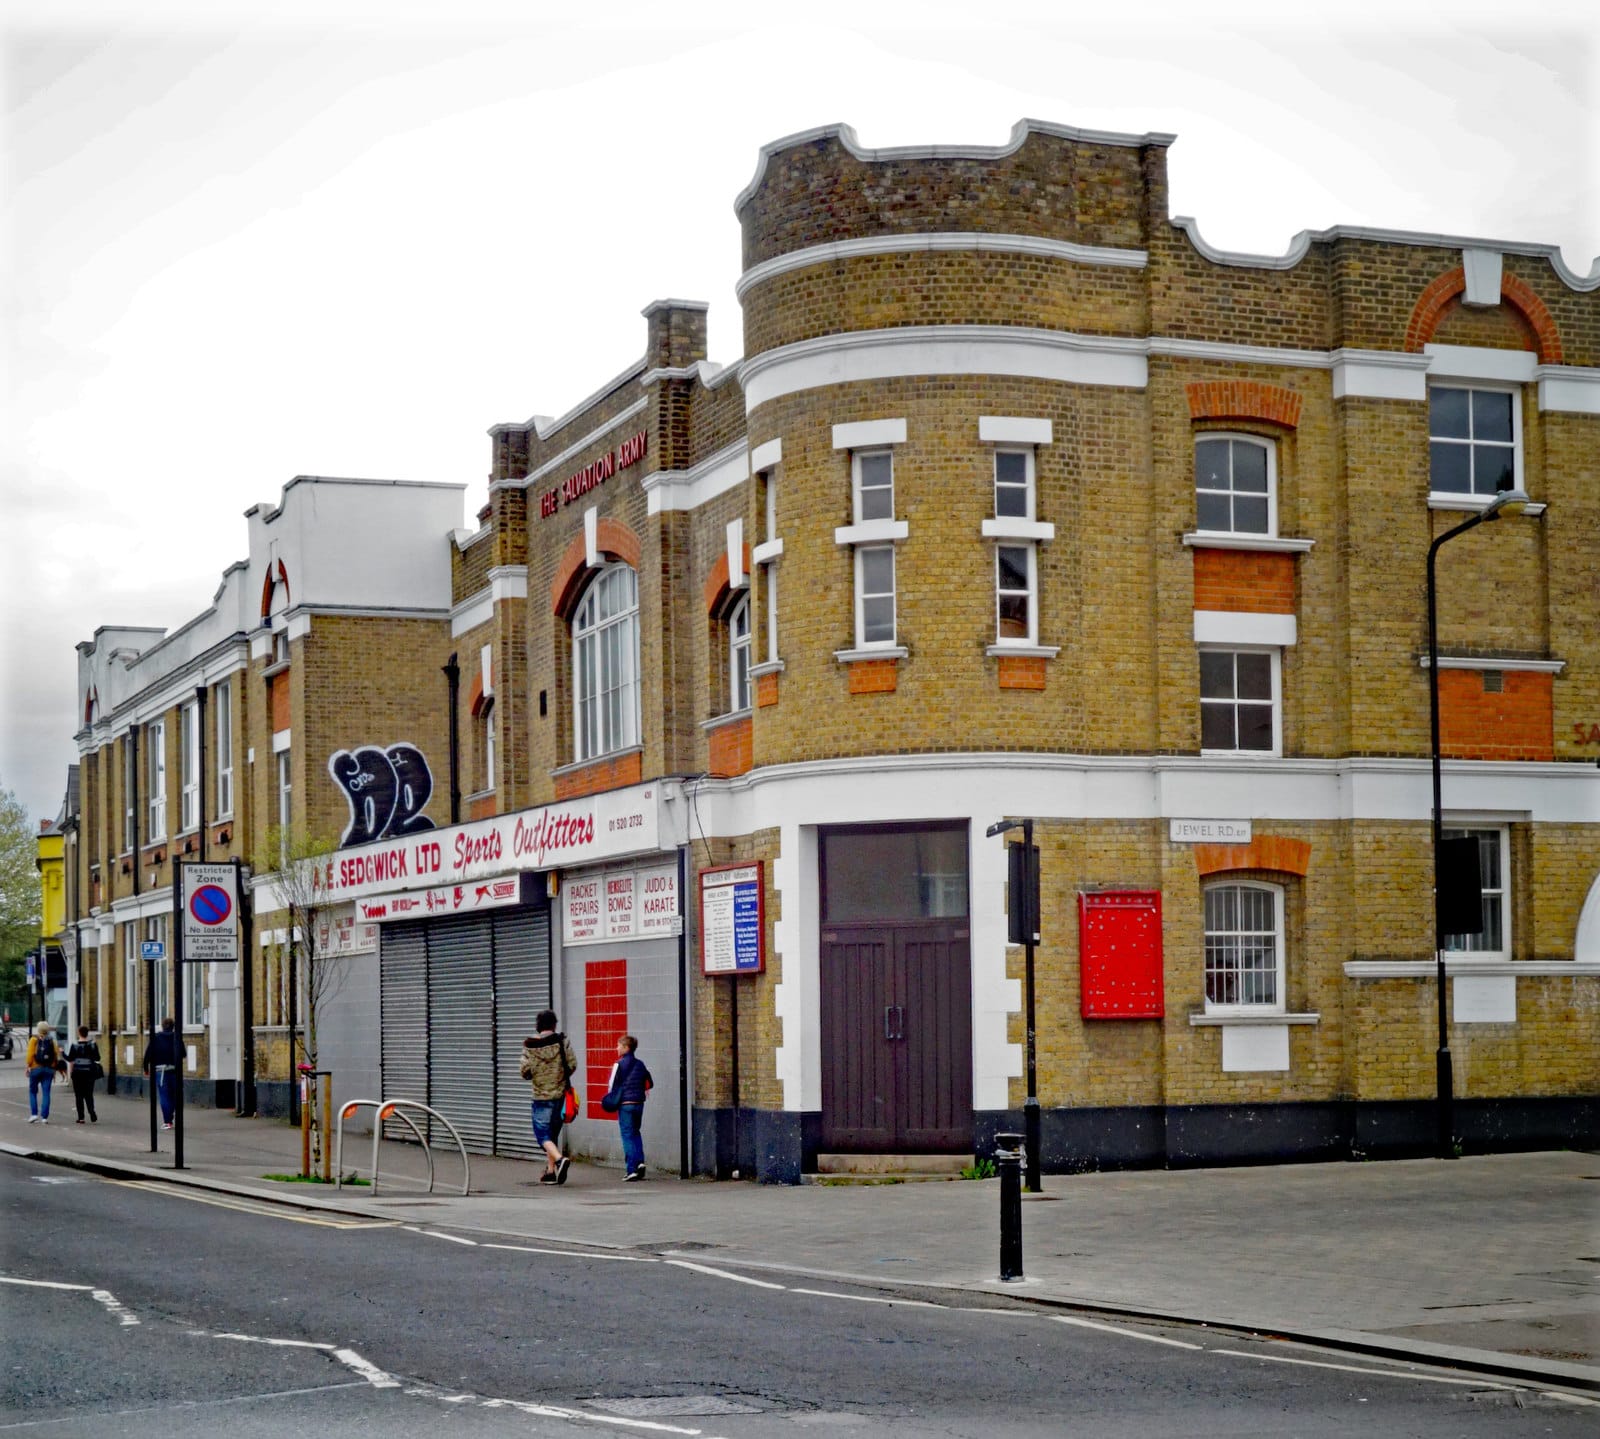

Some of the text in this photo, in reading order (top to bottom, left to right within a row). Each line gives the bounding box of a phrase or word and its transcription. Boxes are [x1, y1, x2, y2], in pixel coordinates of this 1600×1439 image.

[540, 428, 648, 519] THE SALVATION ARMY
[1175, 824, 1214, 836] JEWEL
[340, 848, 408, 888] SEDGWICK
[415, 842, 441, 875] LTD
[453, 828, 503, 875] Sports
[513, 808, 595, 867] Outfitters
[617, 817, 627, 830] 520
[629, 814, 643, 828] 2732
[196, 875, 224, 883] Zone
[644, 877, 673, 893] JUDO &
[570, 883, 598, 899] RACKET
[570, 900, 599, 916] REPAIRS
[608, 896, 632, 912] BOWLS
[644, 897, 675, 913] KARATE
